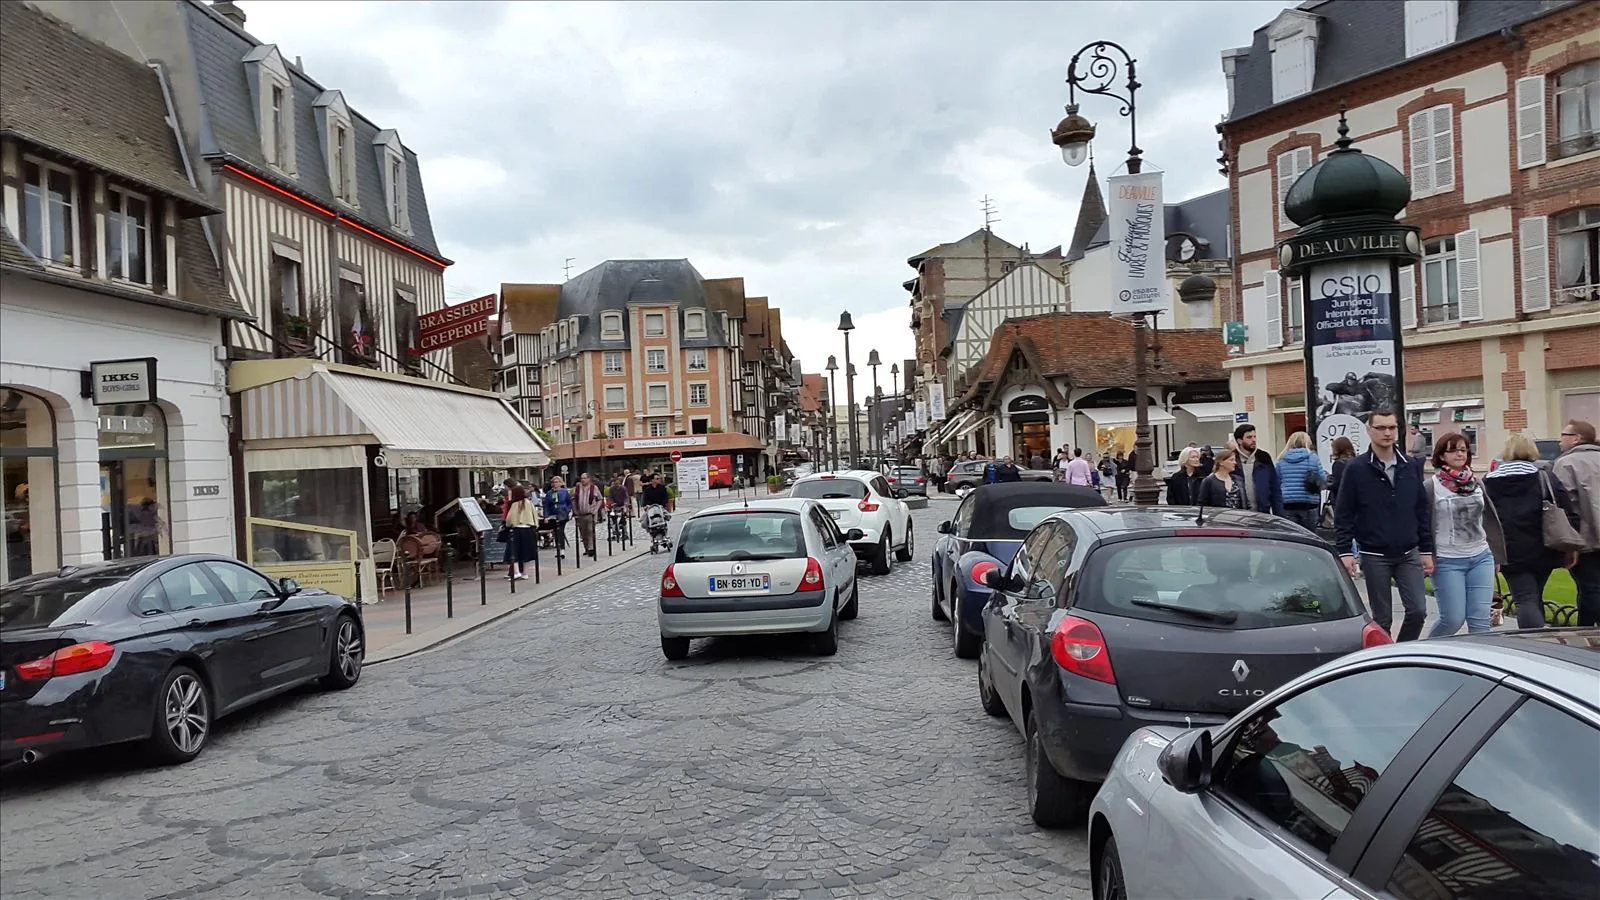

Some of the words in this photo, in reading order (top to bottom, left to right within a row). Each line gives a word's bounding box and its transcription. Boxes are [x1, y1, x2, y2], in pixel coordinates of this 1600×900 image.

[1300, 235, 1400, 258] DEAUVILLE
[1321, 274, 1381, 298] CSIO
[1331, 299, 1372, 308] Jumping
[419, 297, 494, 331] BRASSERIE
[1325, 307, 1379, 319] International
[1316, 320, 1345, 331] Officiel
[1346, 318, 1359, 327] de
[1360, 317, 1390, 326] France
[420, 319, 488, 349] CREPERIE
[102, 373, 139, 382] IKKS
[1328, 424, 1347, 437] 07
[193, 485, 219, 496] IKKS
[1218, 689, 1265, 697] CLIO
